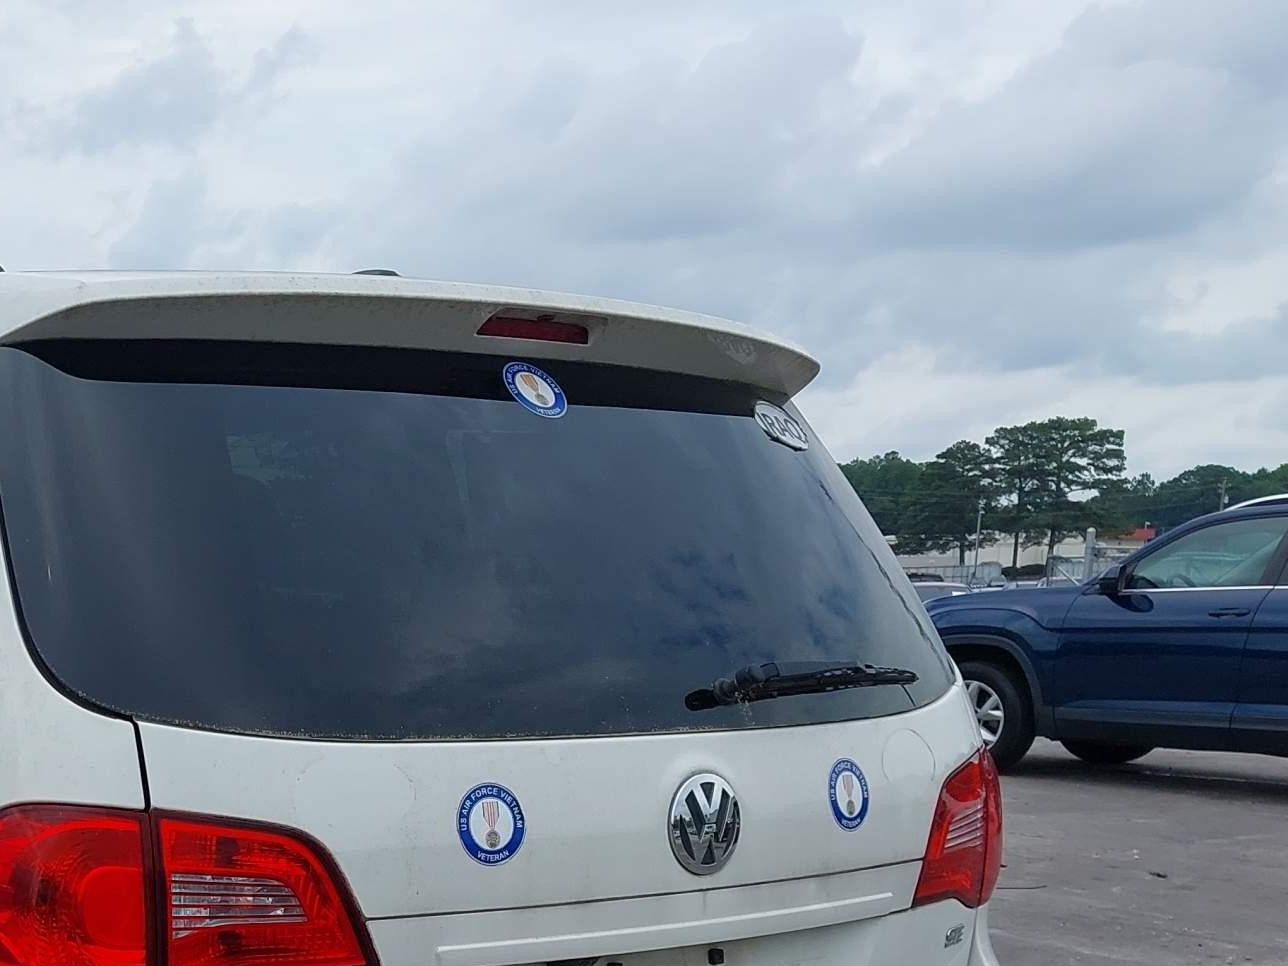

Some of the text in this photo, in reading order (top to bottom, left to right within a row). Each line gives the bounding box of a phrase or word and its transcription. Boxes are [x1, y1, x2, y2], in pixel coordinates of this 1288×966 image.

[756, 412, 807, 444] IRAQ
[460, 786, 524, 832] US AIR FORCE VIETNAM
[477, 849, 510, 862] VETERAN
